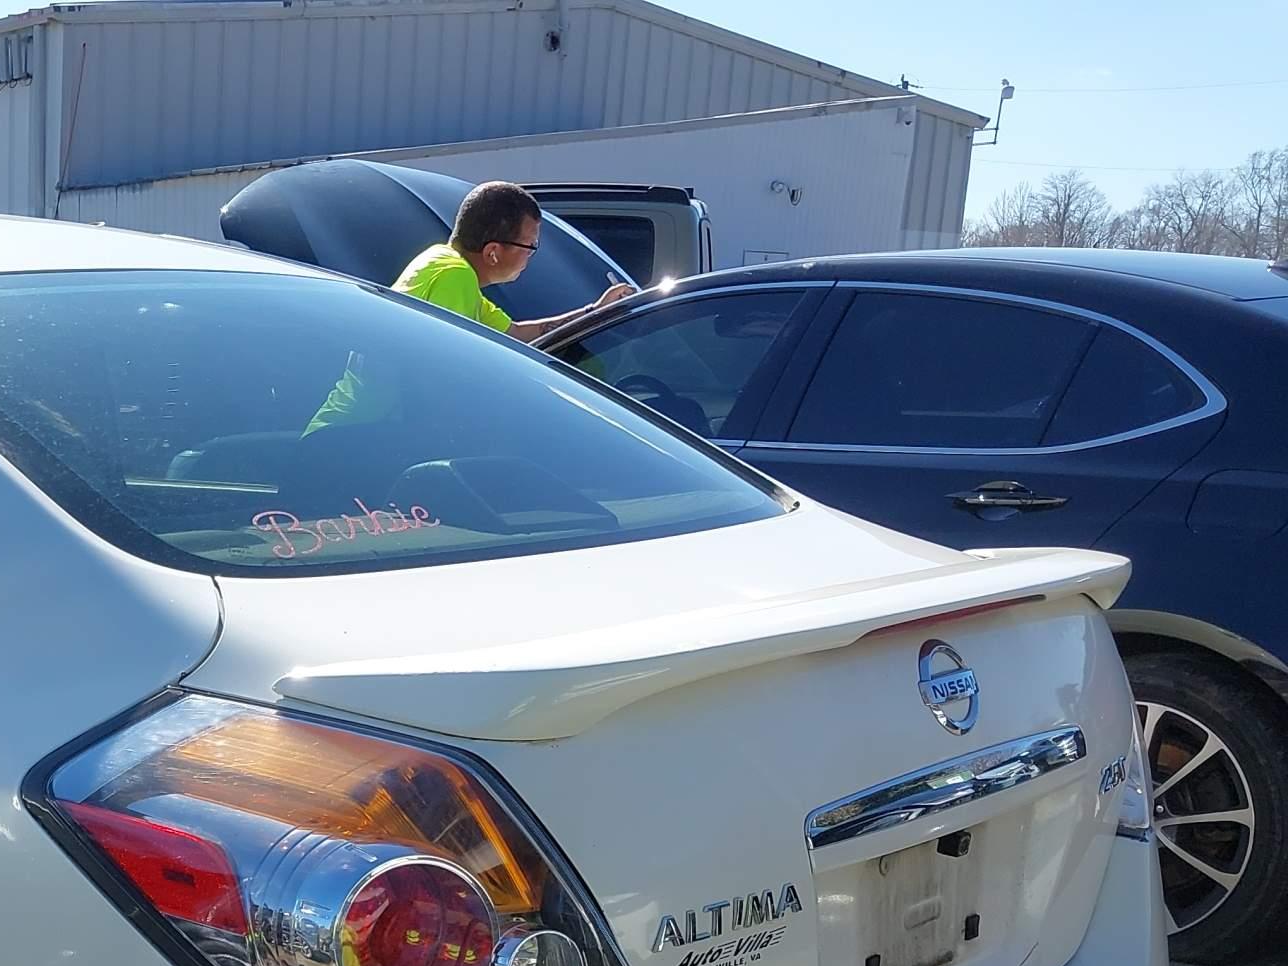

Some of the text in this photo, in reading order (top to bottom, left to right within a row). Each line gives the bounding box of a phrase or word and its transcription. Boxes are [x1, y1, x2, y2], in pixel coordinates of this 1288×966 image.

[252, 497, 441, 558] Barbie
[651, 881, 803, 953] ALTIMA
[733, 930, 773, 957] Villa
[750, 952, 761, 962] VA
